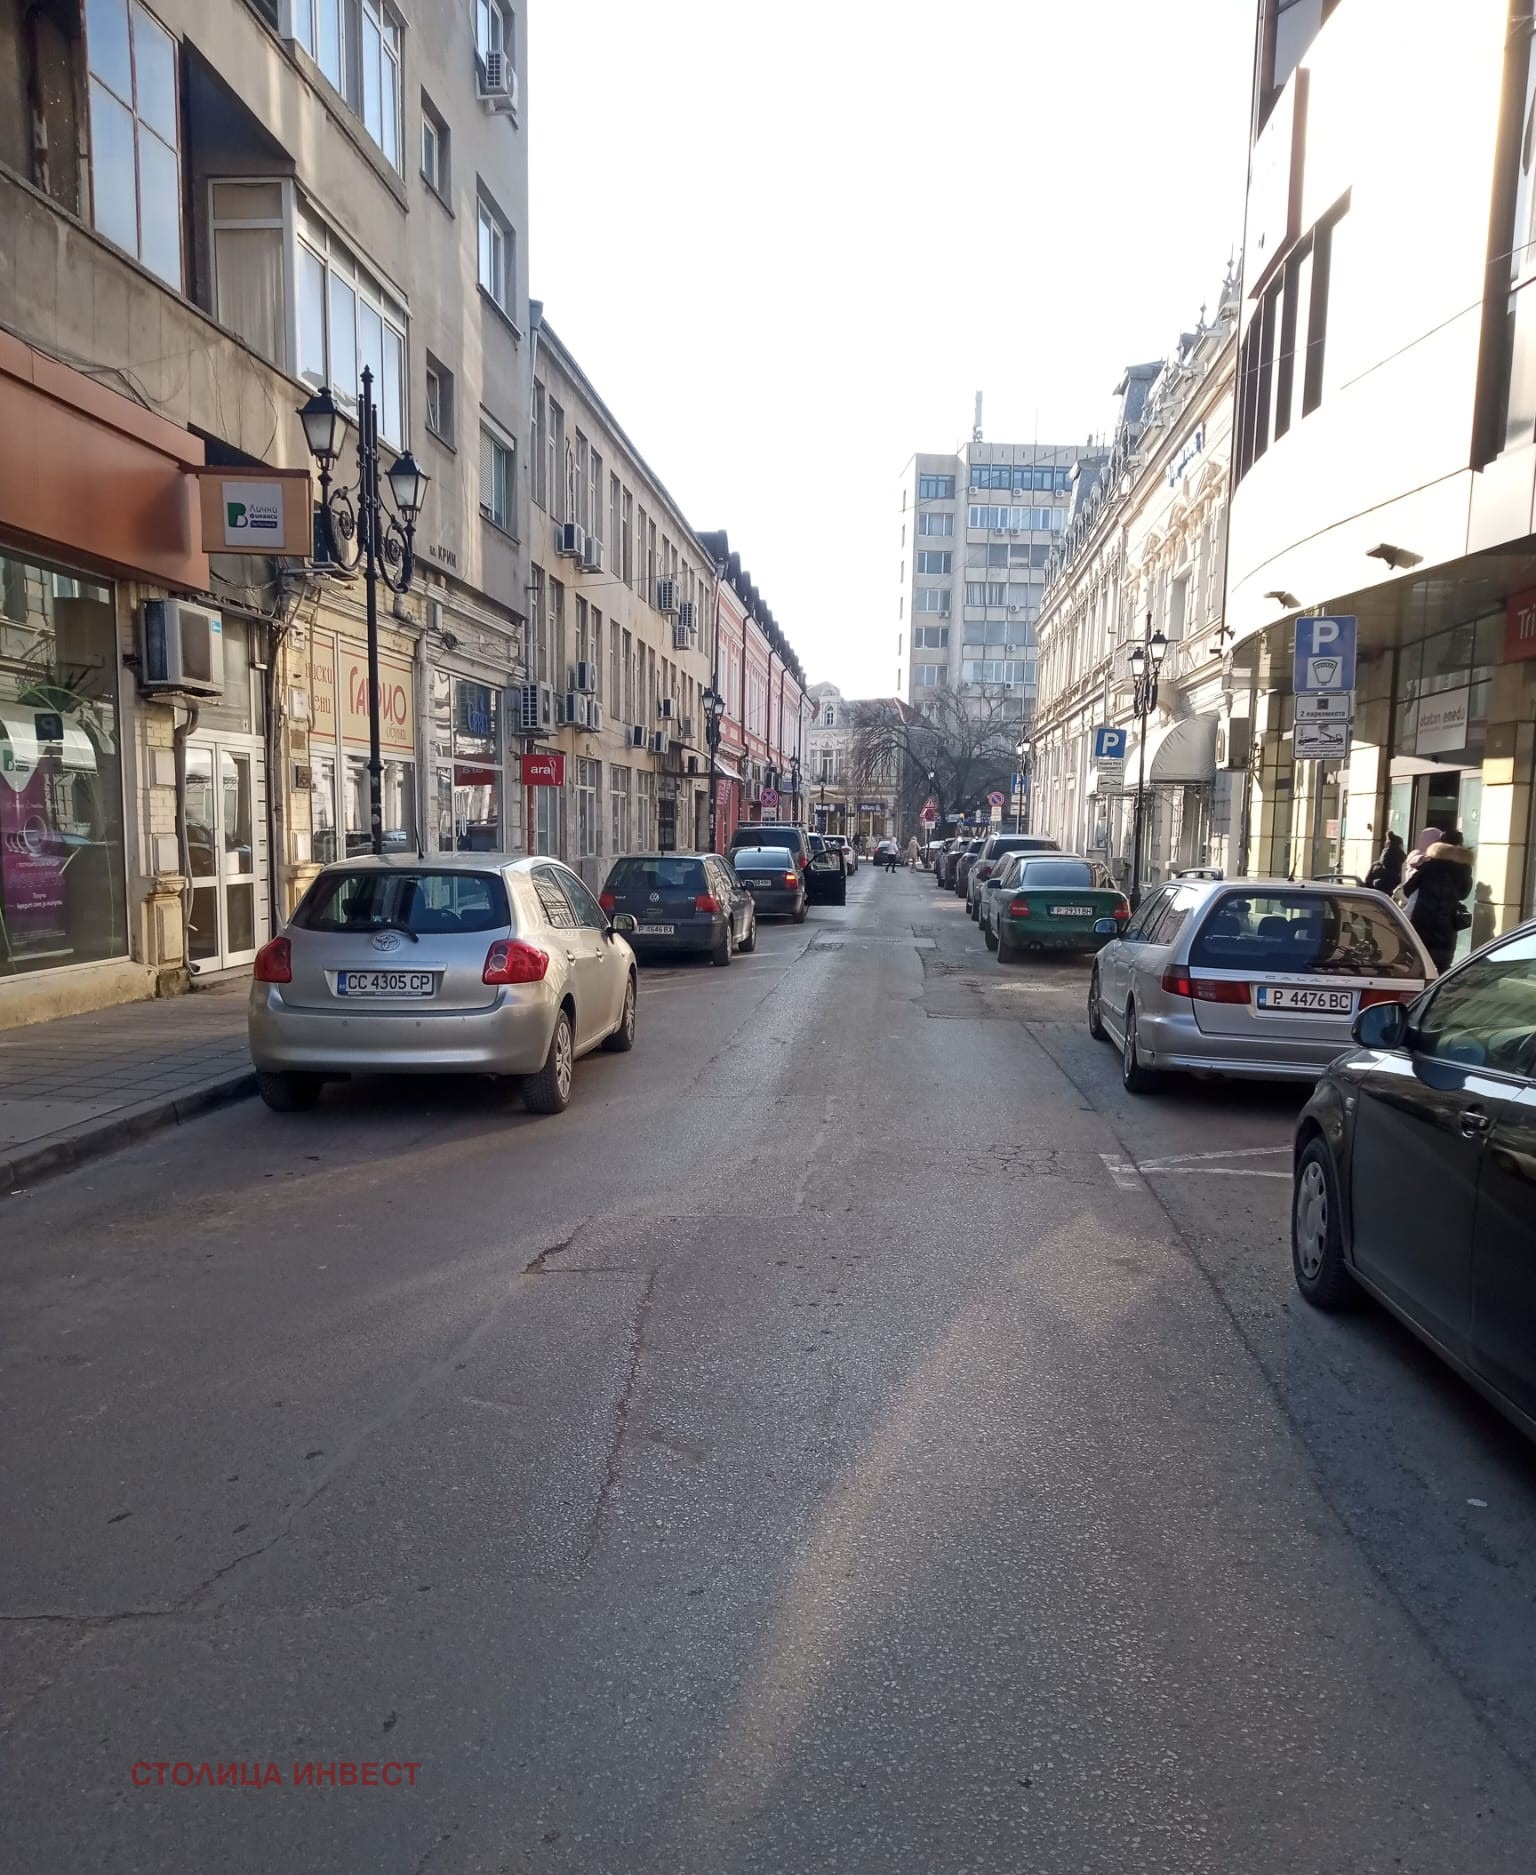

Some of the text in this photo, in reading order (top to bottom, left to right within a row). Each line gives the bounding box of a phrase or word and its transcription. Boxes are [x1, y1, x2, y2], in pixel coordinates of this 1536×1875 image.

[438, 544, 457, 569] КРИМ
[1312, 620, 1339, 654] P
[1102, 732, 1119, 754] P
[531, 765, 551, 775] ara
[348, 975, 430, 990] CC 4305 CP
[1290, 991, 1326, 1007] 4476
[1329, 994, 1349, 1009] BC
